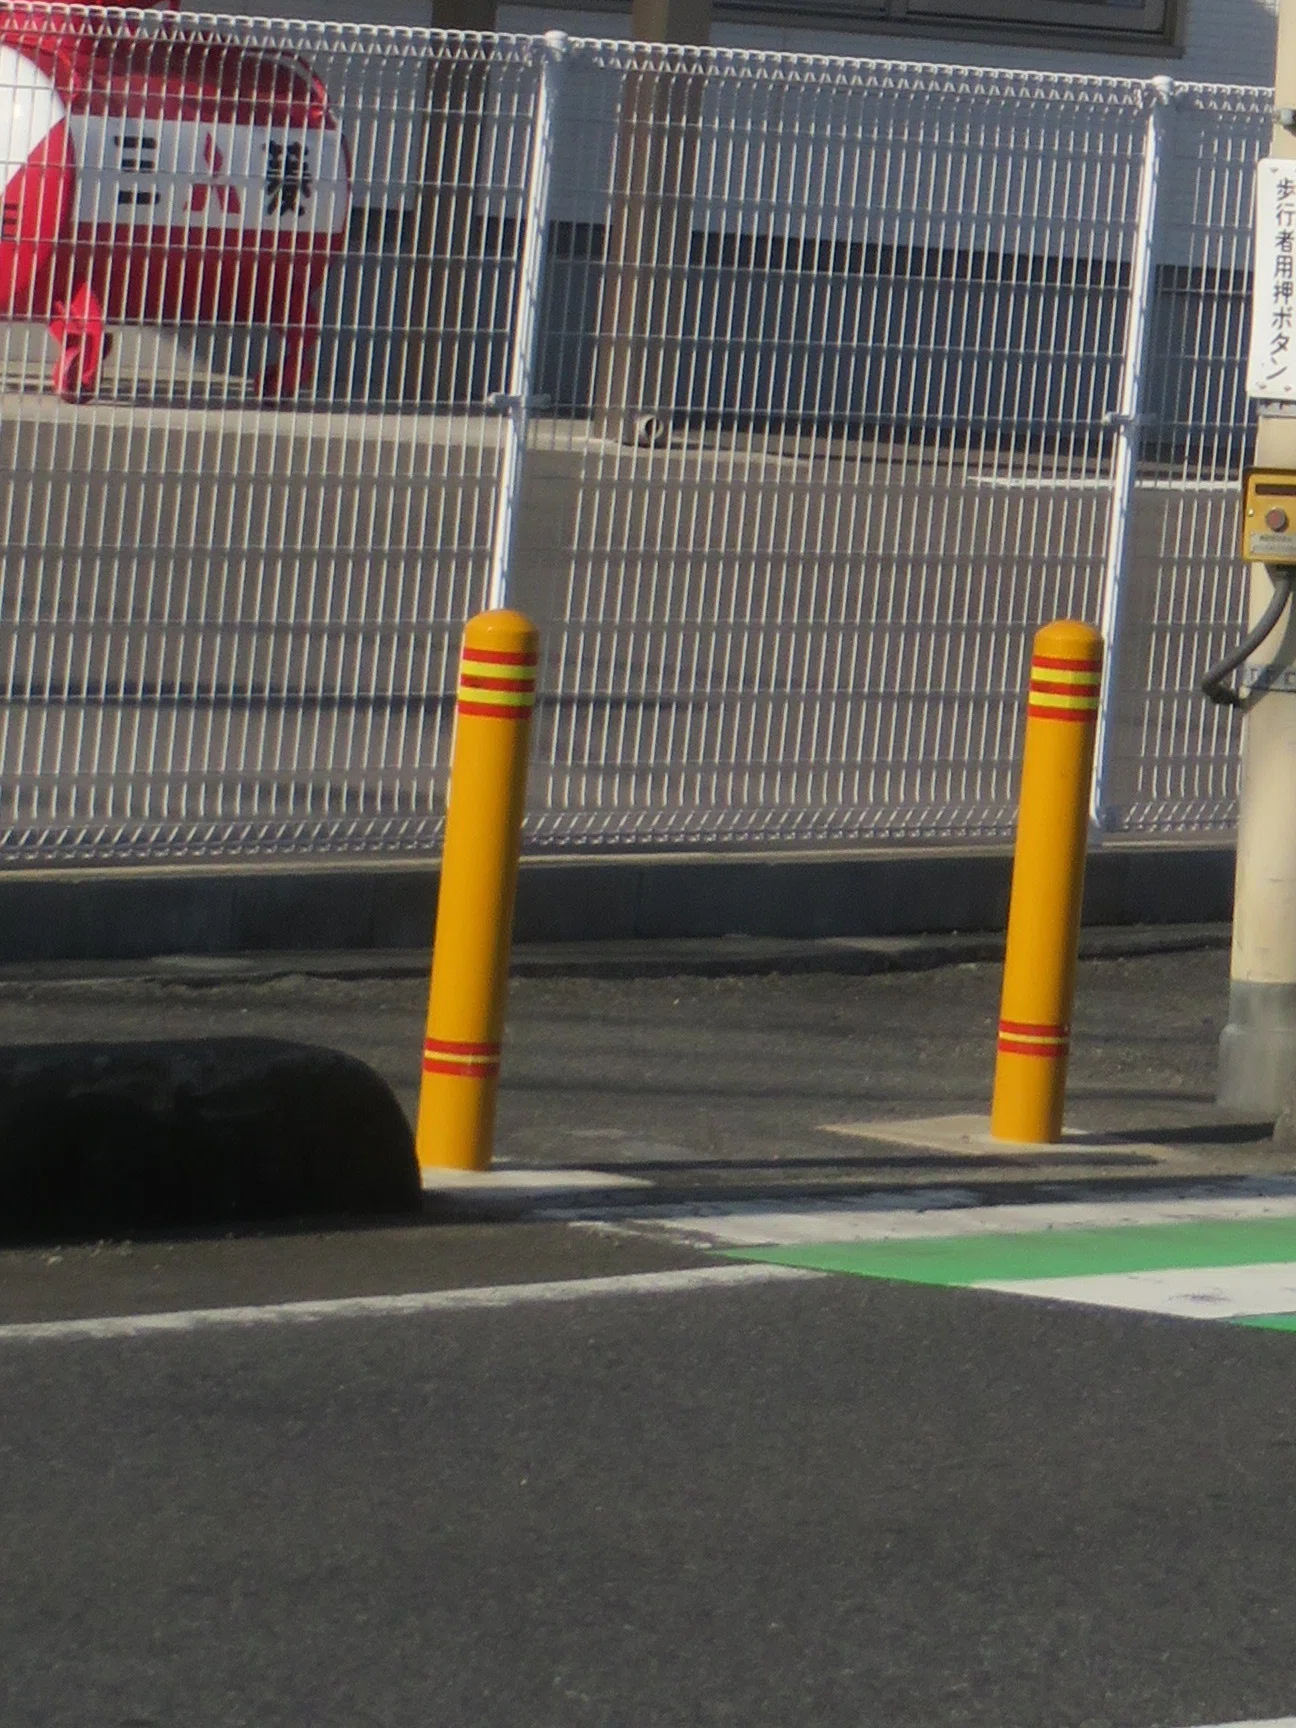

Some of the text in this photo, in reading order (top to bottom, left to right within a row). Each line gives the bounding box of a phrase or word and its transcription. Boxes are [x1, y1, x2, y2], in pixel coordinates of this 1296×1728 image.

[1265, 177, 1296, 380] 歩行者用押ボタン
